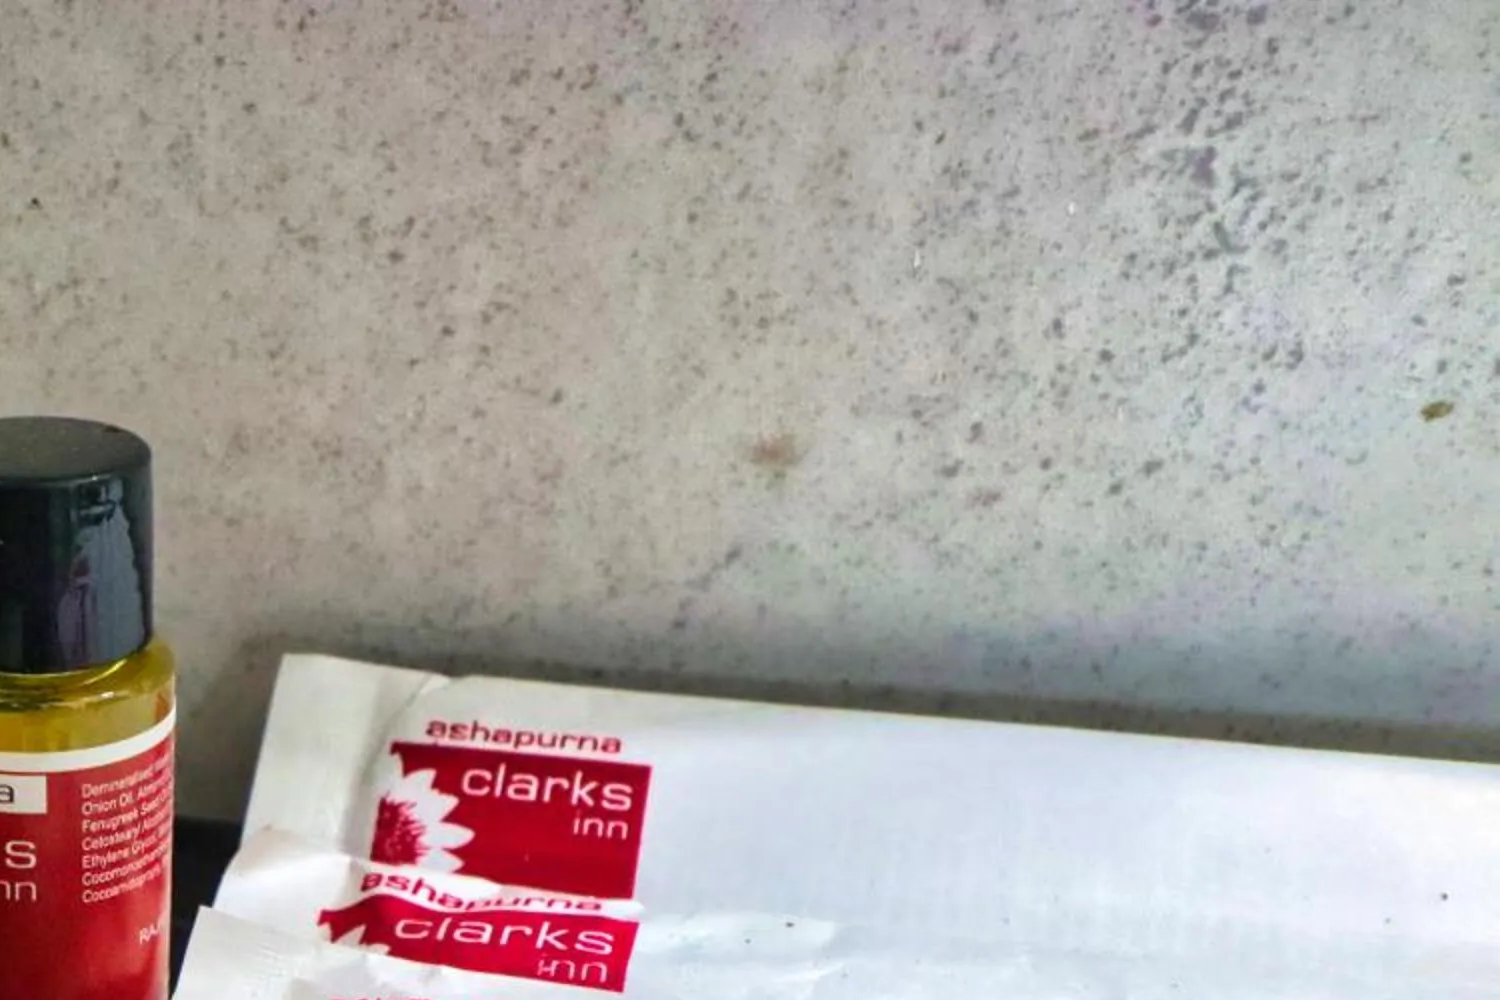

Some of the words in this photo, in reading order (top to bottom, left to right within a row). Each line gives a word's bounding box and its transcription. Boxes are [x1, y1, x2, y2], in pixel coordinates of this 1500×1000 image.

[426, 719, 622, 754] ashapurna
[461, 763, 633, 812] clarks
[573, 815, 629, 841] inn
[361, 872, 601, 911] ashapurna
[394, 917, 615, 955] clarks
[536, 953, 608, 983] inn
